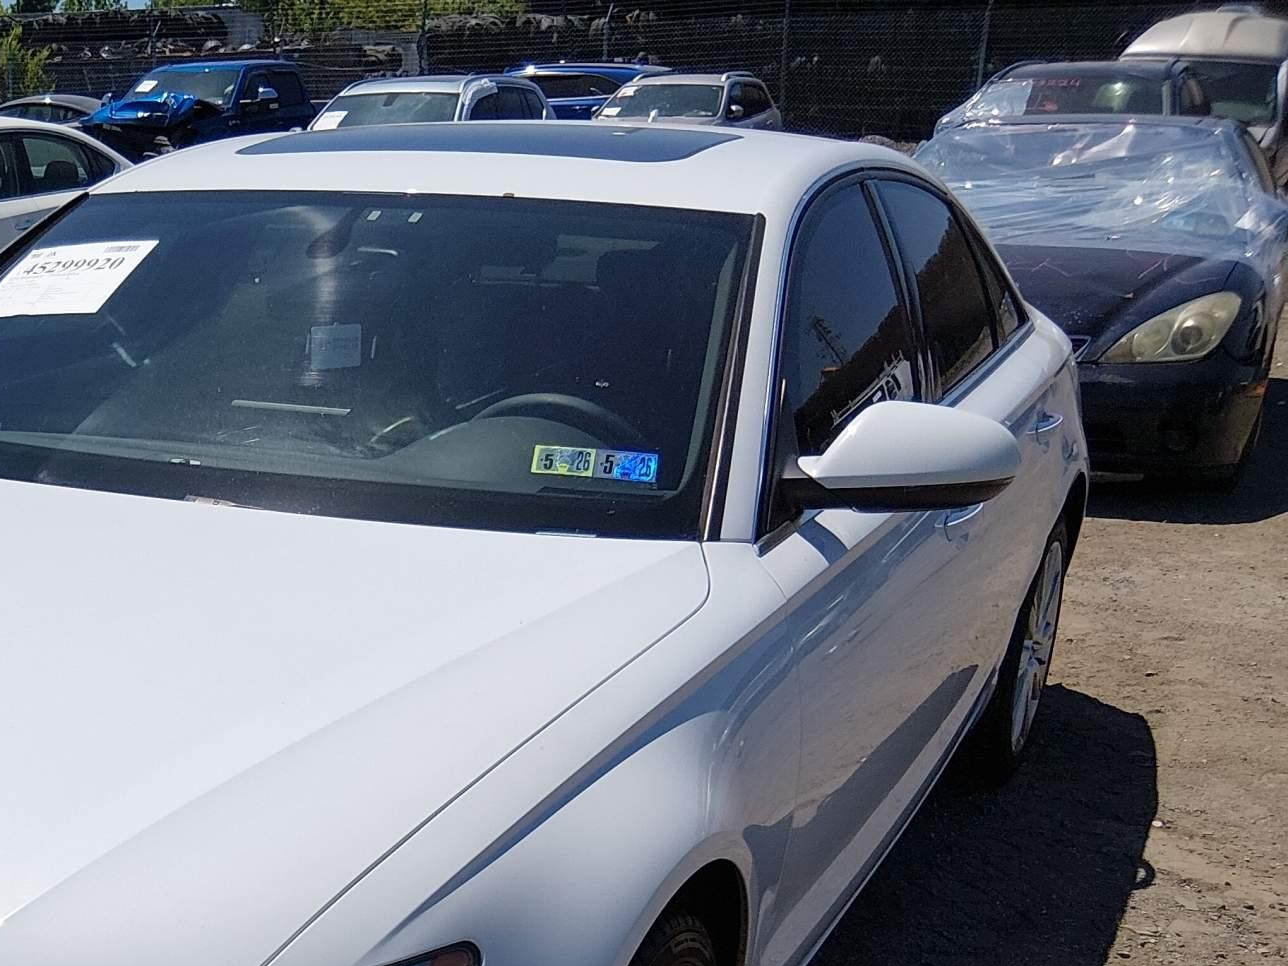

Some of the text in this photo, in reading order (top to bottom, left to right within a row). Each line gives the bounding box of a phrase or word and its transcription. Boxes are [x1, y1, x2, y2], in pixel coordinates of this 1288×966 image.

[23, 257, 125, 275] 45299920
[576, 451, 592, 471] 26
[639, 457, 654, 478] 26
